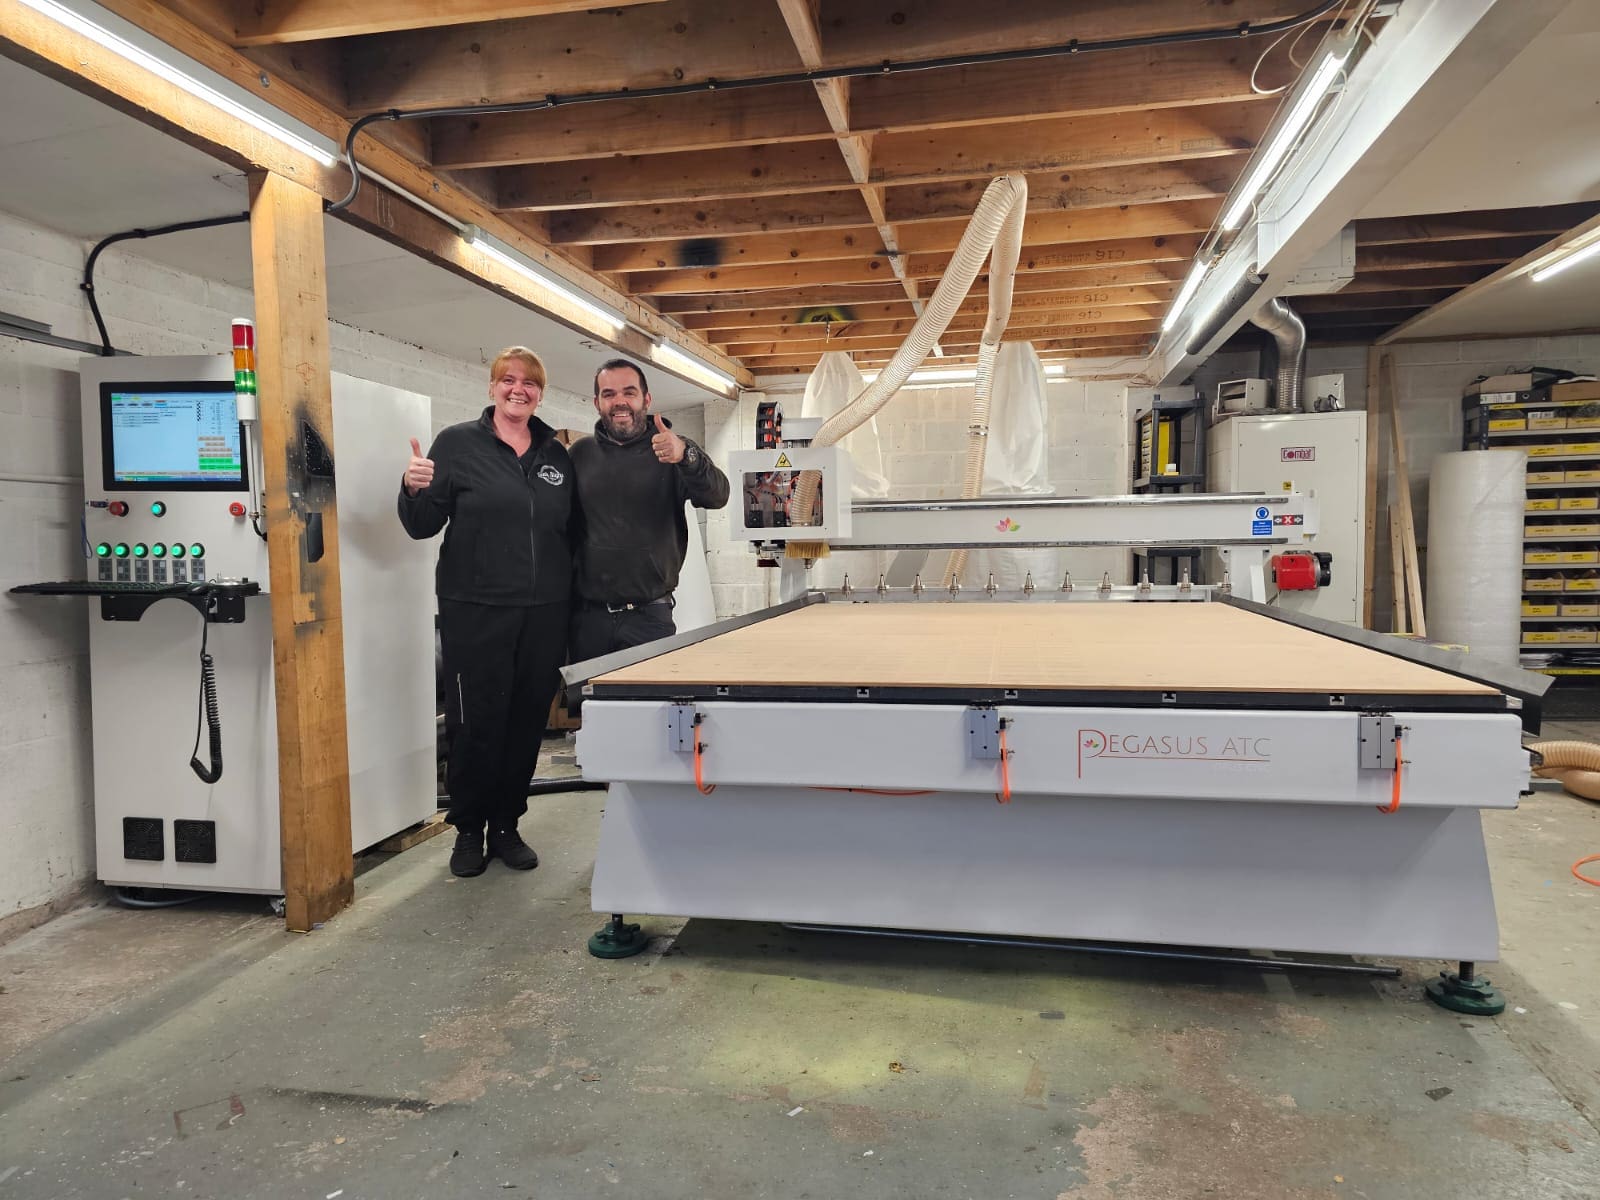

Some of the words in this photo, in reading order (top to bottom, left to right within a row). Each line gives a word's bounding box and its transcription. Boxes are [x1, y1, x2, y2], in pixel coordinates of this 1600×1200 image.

[1095, 249, 1126, 261] C16
[1083, 293, 1109, 304] C16
[1078, 310, 1103, 320] C16
[1075, 325, 1097, 334] C16
[1078, 729, 1208, 778] PEGASUS
[1221, 737, 1272, 757] ATC
